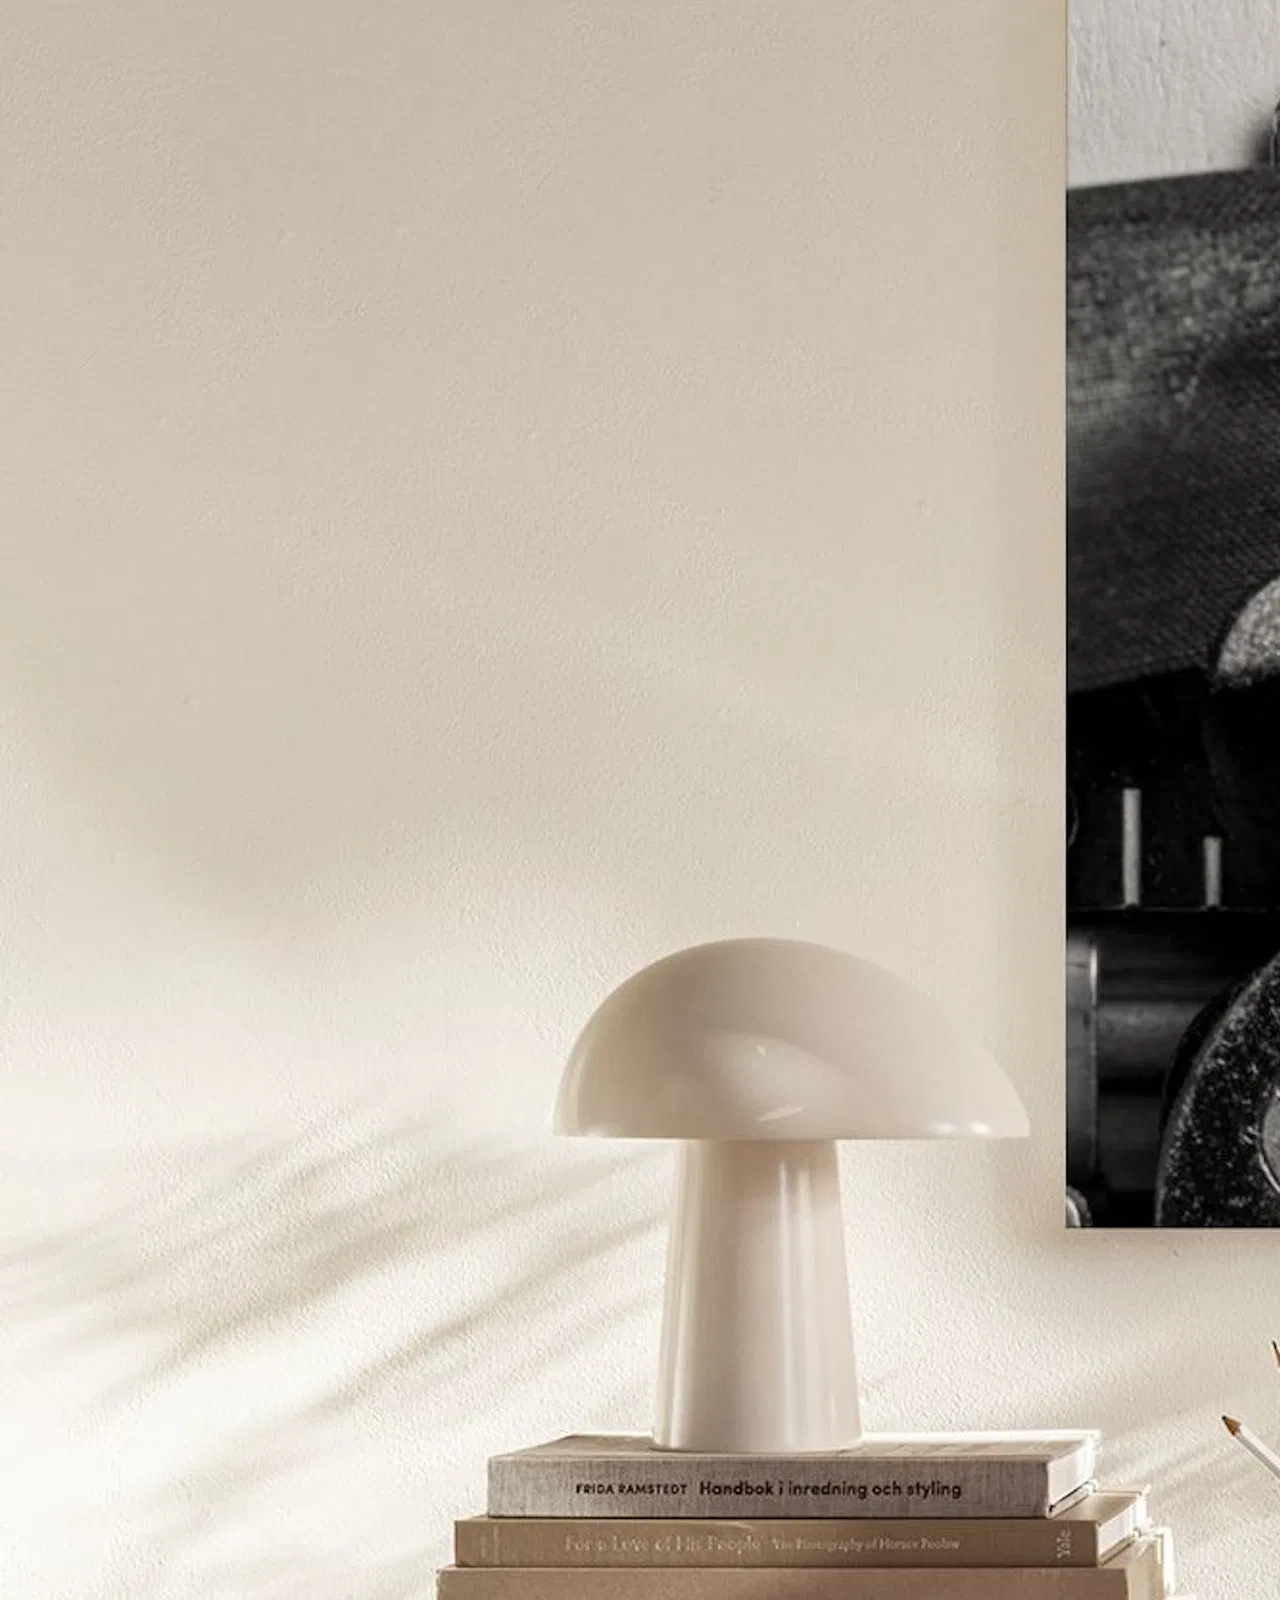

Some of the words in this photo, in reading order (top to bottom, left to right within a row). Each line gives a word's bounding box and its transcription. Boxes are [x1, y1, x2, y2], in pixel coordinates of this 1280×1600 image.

[575, 1483, 615, 1495] FRIDA
[618, 1483, 688, 1495] RAMSTEDT
[699, 1481, 775, 1496] Handbok
[778, 1480, 784, 1496] i
[788, 1480, 868, 1499] inredning
[872, 1480, 902, 1496] och
[907, 1481, 962, 1499] styling
[706, 1534, 762, 1555] People
